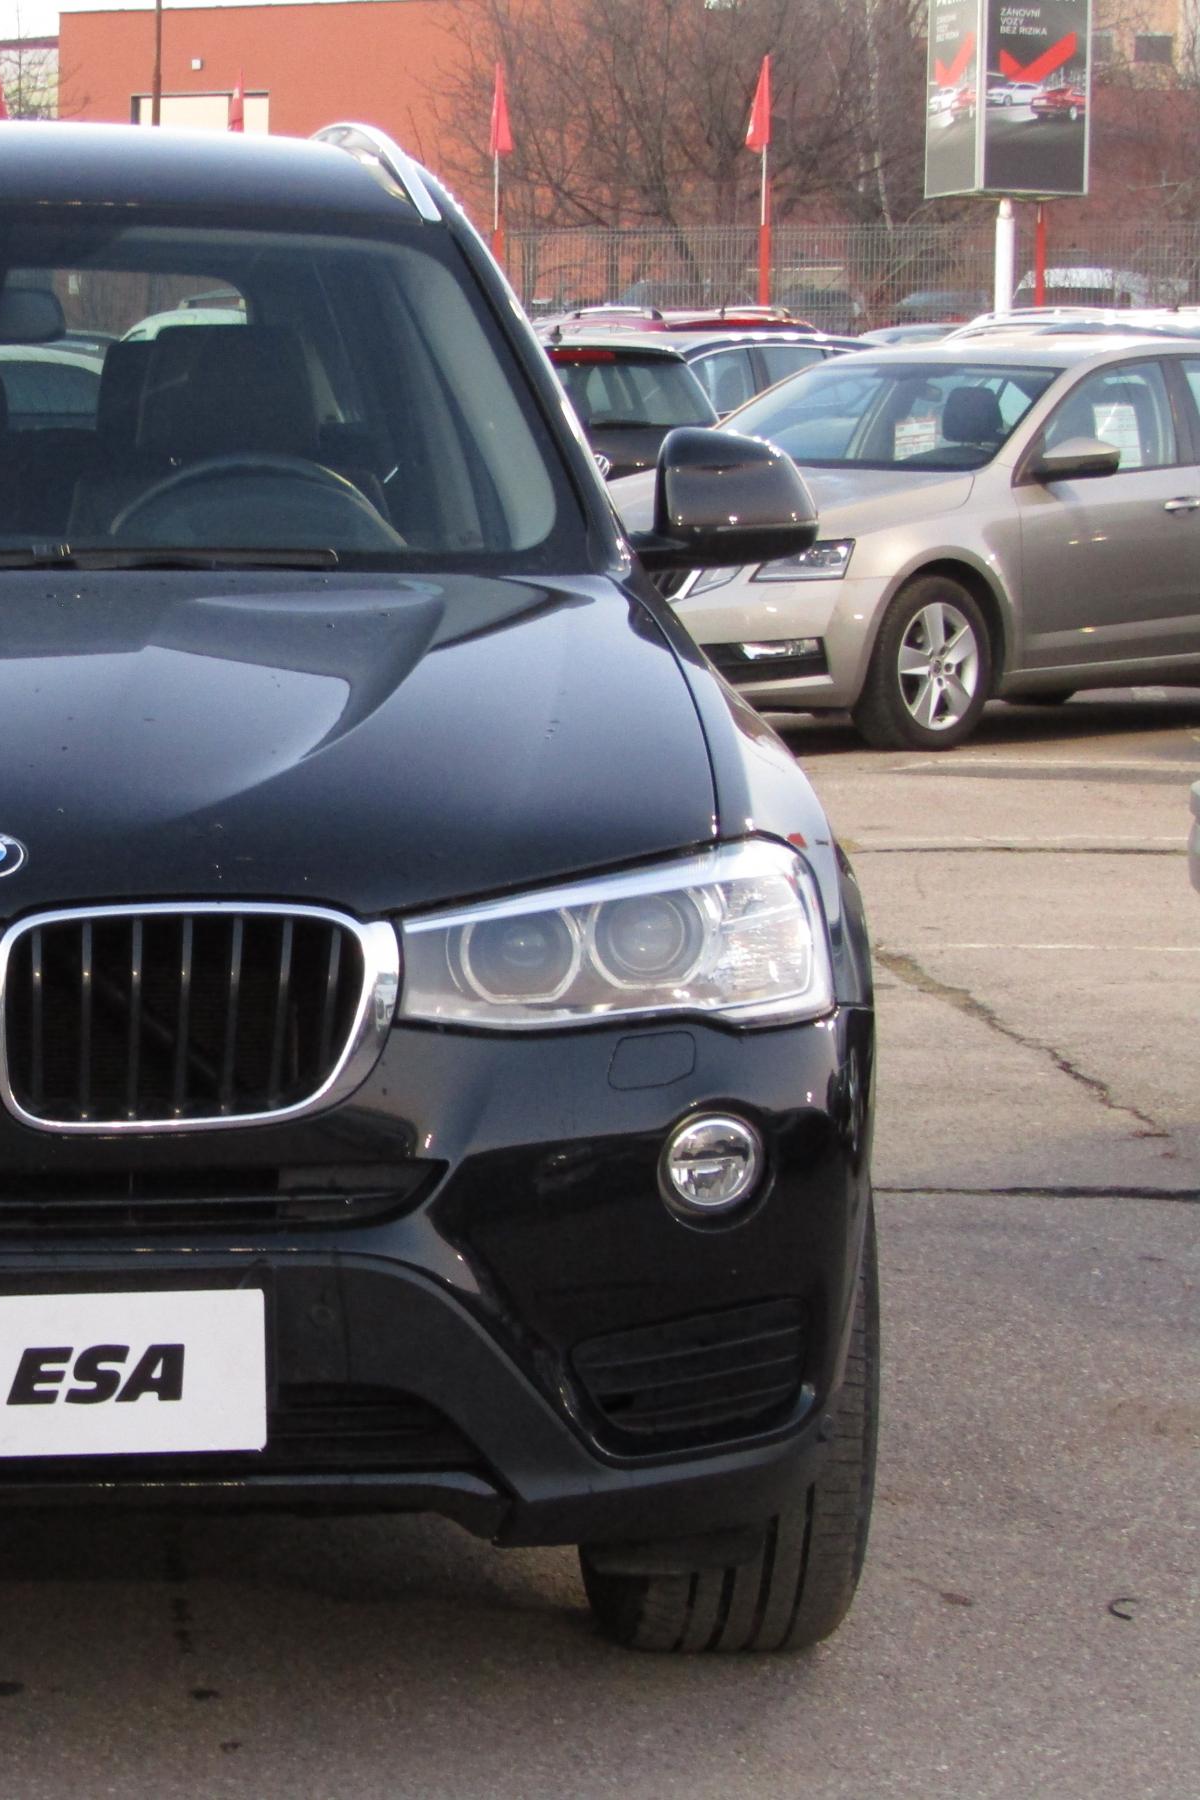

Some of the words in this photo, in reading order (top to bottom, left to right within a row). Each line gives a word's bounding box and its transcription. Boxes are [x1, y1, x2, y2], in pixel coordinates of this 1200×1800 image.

[1000, 17, 1024, 26] VOZY
[1000, 26, 1017, 35] BEZ
[1019, 26, 1048, 36] RIZIKA
[6, 1343, 185, 1406] ESA
